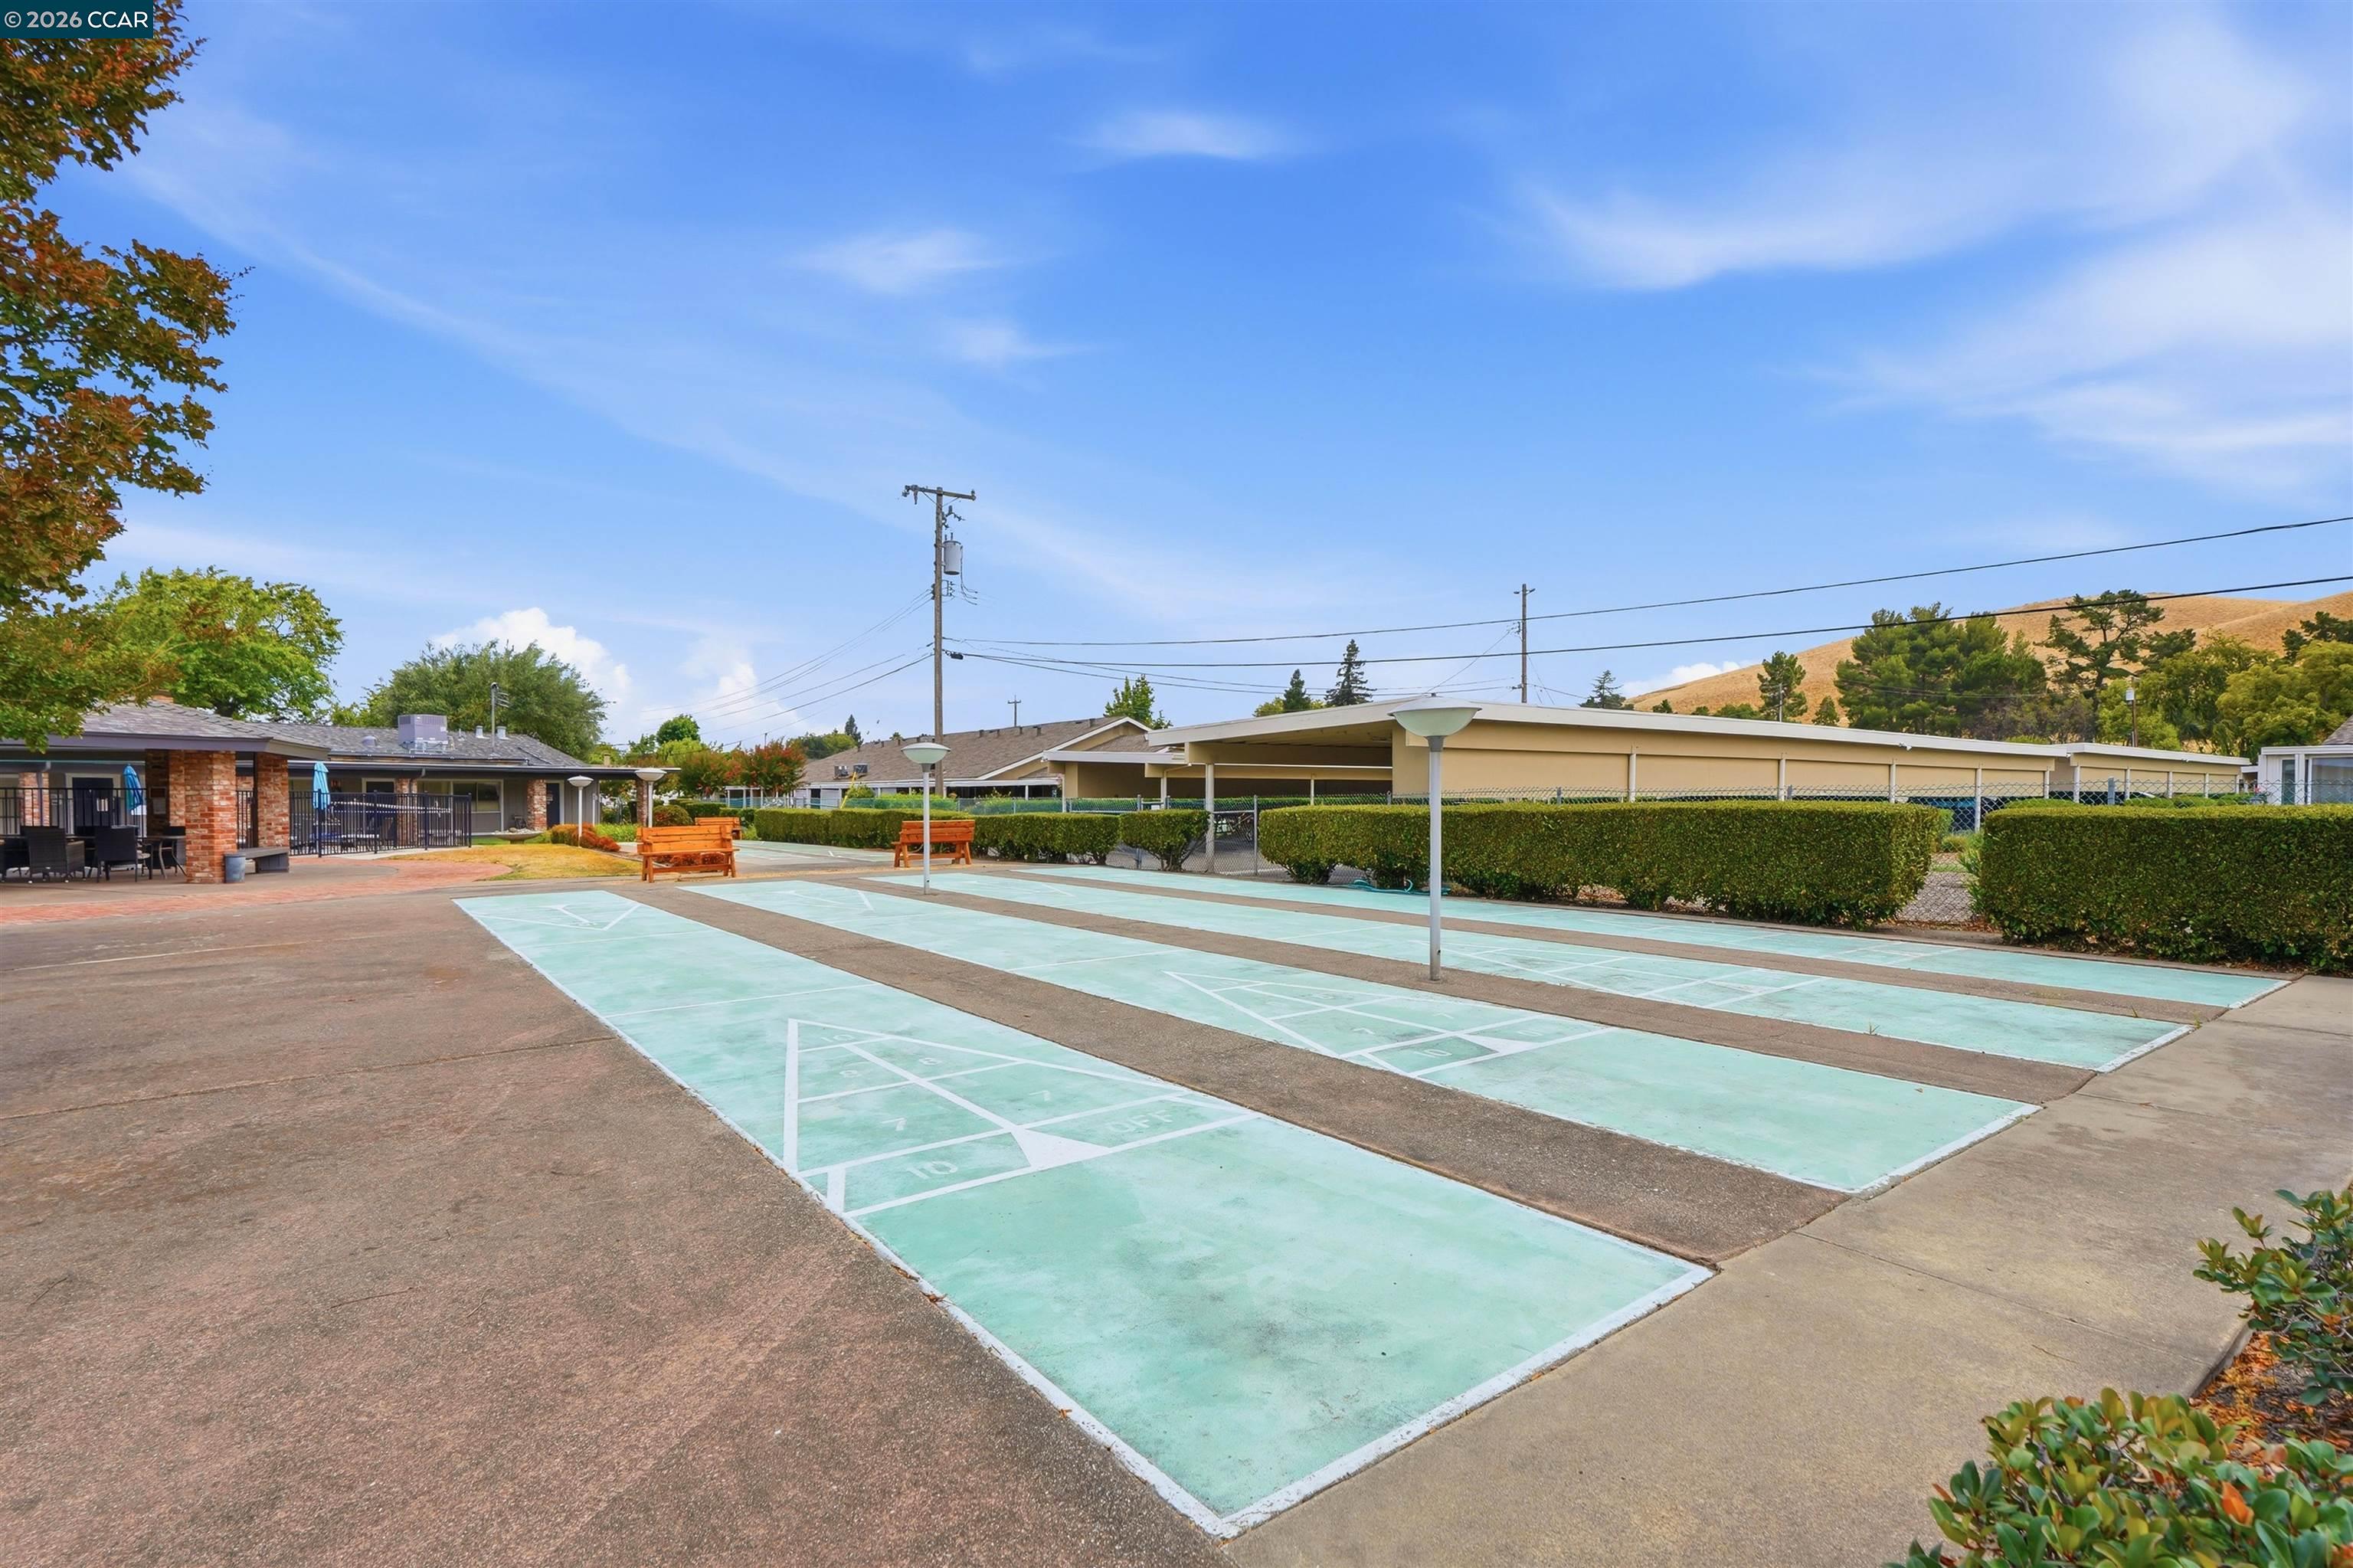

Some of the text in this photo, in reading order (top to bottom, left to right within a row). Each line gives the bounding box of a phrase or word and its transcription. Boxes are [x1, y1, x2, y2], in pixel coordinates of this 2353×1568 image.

[1413, 1049, 1454, 1059] 10
[881, 1117, 907, 1131] 7
[1105, 1110, 1173, 1133] OFF
[906, 1160, 958, 1180] 10
